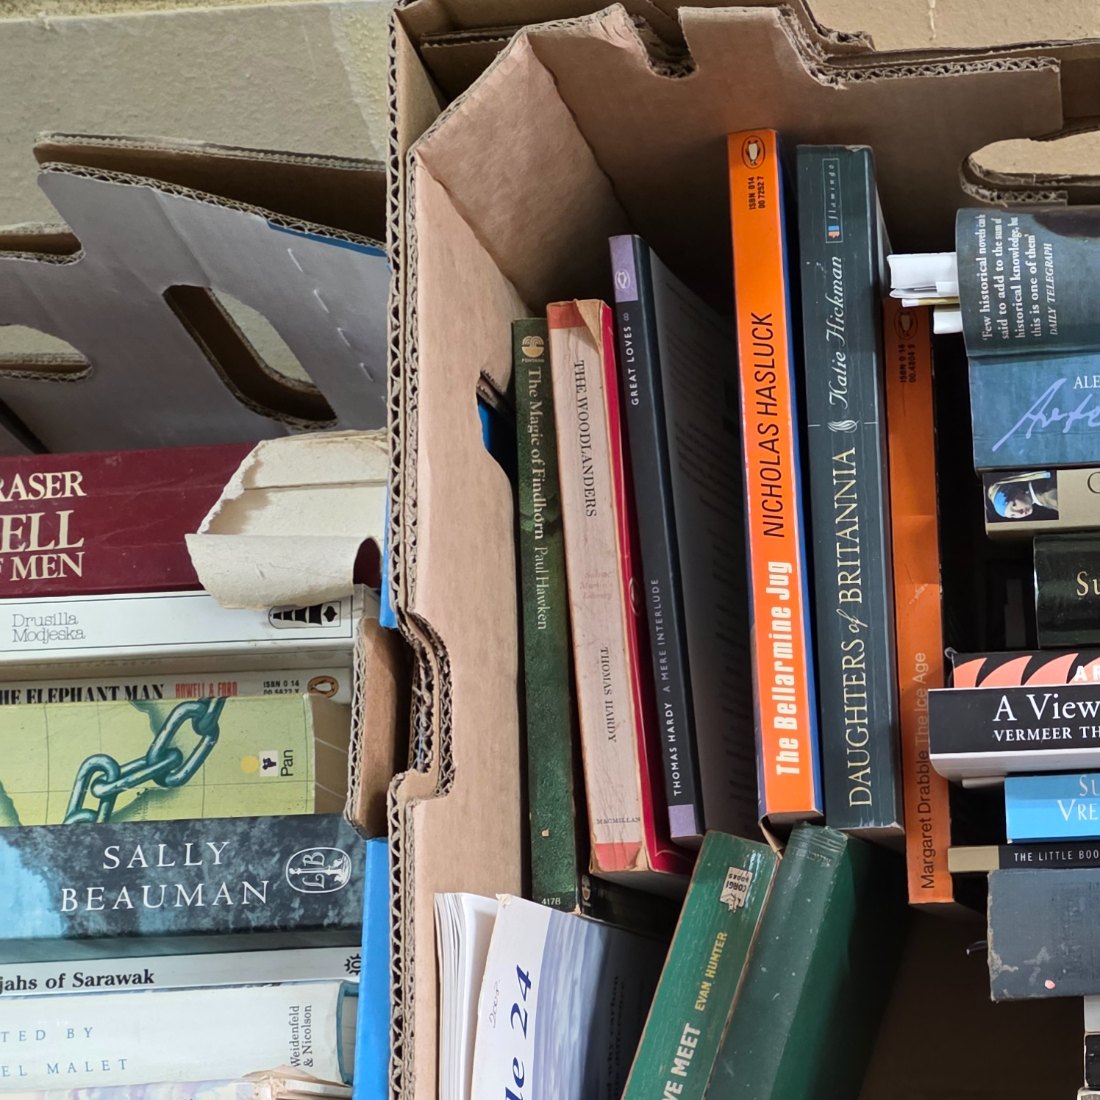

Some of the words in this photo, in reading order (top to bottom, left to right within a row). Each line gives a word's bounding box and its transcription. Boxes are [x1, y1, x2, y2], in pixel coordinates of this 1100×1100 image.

[976, 257, 991, 313] historical
[1010, 285, 1026, 339] historical
[625, 325, 636, 363] LOVES
[752, 311, 779, 417] HASLUCK
[573, 360, 588, 397] THE
[630, 366, 640, 406] GREAT
[575, 397, 598, 518] WOODLANDERS
[761, 422, 786, 539] NICHOLAS
[835, 446, 864, 605] BRITANNIA
[765, 560, 793, 602] Jug
[835, 607, 869, 635] of
[767, 605, 799, 721] Bellarmine
[839, 638, 873, 808] DAUGHTERS
[992, 694, 1018, 722] A
[774, 729, 801, 776] The
[993, 727, 1073, 743] VERMEER
[280, 749, 294, 777] Pan
[102, 841, 230, 871] SALLY
[1014, 851, 1034, 863] THE
[1038, 850, 1073, 862] LITTLE
[61, 881, 270, 912] BEAUMAN
[45, 975, 65, 994] of
[72, 971, 155, 993] Sarawak
[509, 963, 533, 1040] 24
[671, 1023, 701, 1080] MEET
[694, 978, 713, 1012] EVAN
[704, 931, 728, 978] HUNTER
[289, 1005, 301, 1068] Weidenfeld
